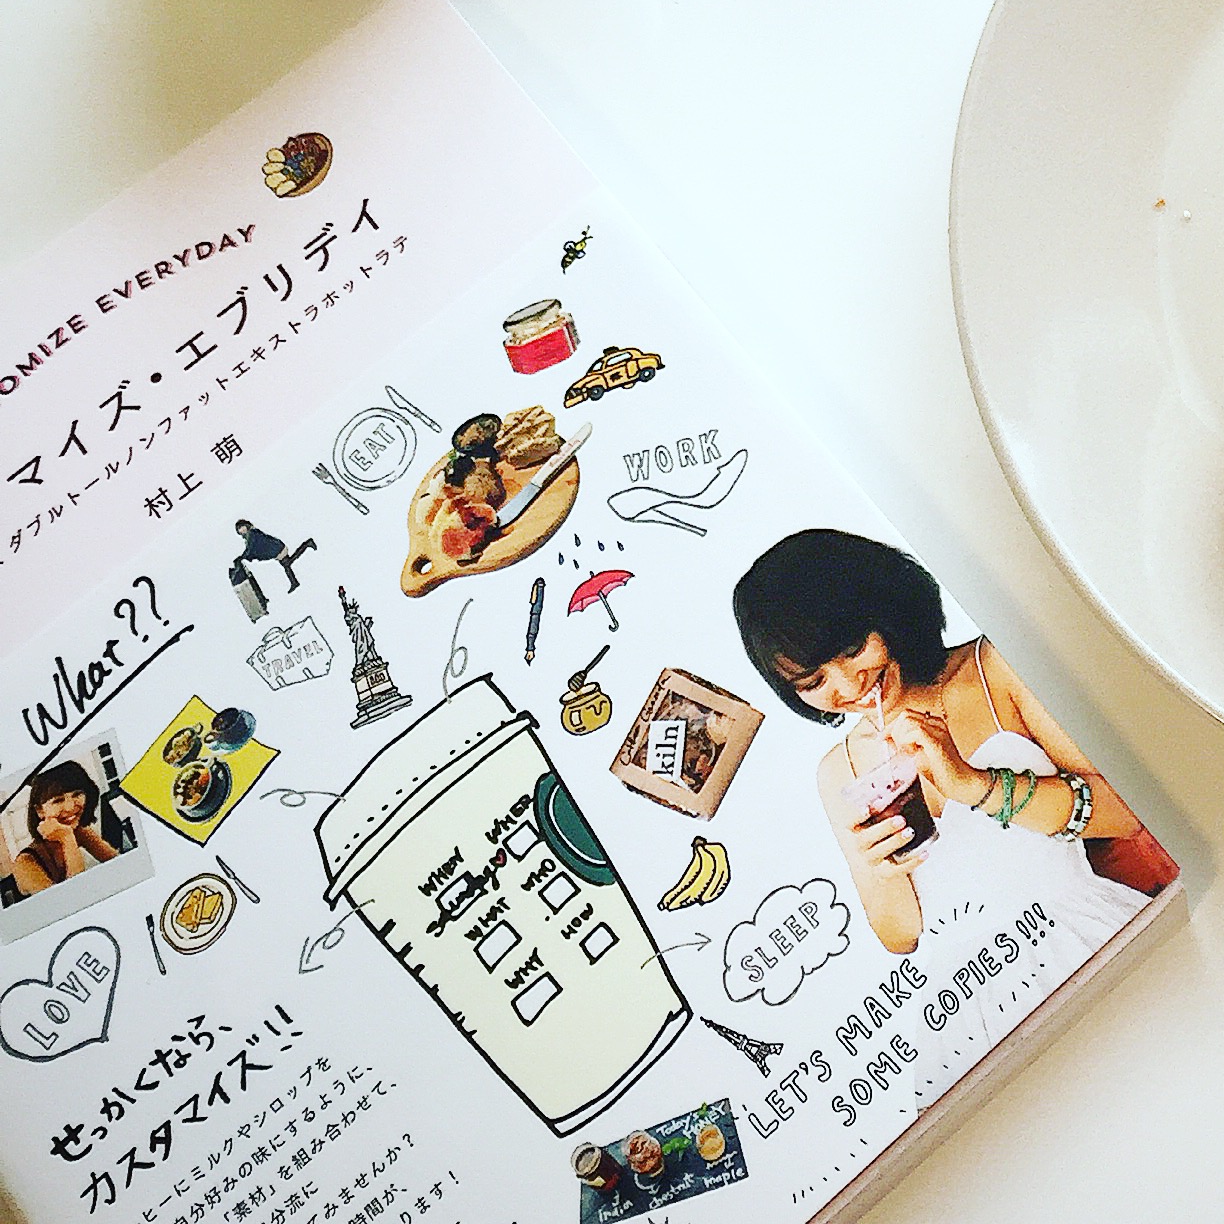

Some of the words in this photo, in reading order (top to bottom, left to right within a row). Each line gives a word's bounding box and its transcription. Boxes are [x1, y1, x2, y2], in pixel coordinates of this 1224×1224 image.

[95, 223, 257, 314] EVERYDAY
[144, 472, 204, 519] 村上
[210, 433, 244, 465] 萌
[347, 422, 398, 473] EAT
[623, 429, 722, 482] WORK
[261, 640, 324, 678] TRAVEL
[652, 725, 680, 776] kiln
[520, 858, 557, 892] WHO
[740, 901, 820, 983] SLEEP
[22, 951, 111, 1051] LOVE
[831, 1034, 919, 1127] SOME
[923, 903, 1055, 1032] COPIES!!!
[748, 1050, 832, 1139] LET'S
[835, 958, 928, 1057] MAKE
[137, 1056, 332, 1224] ヒーにミルクやシロップを
[261, 1180, 319, 1224] 分流に
